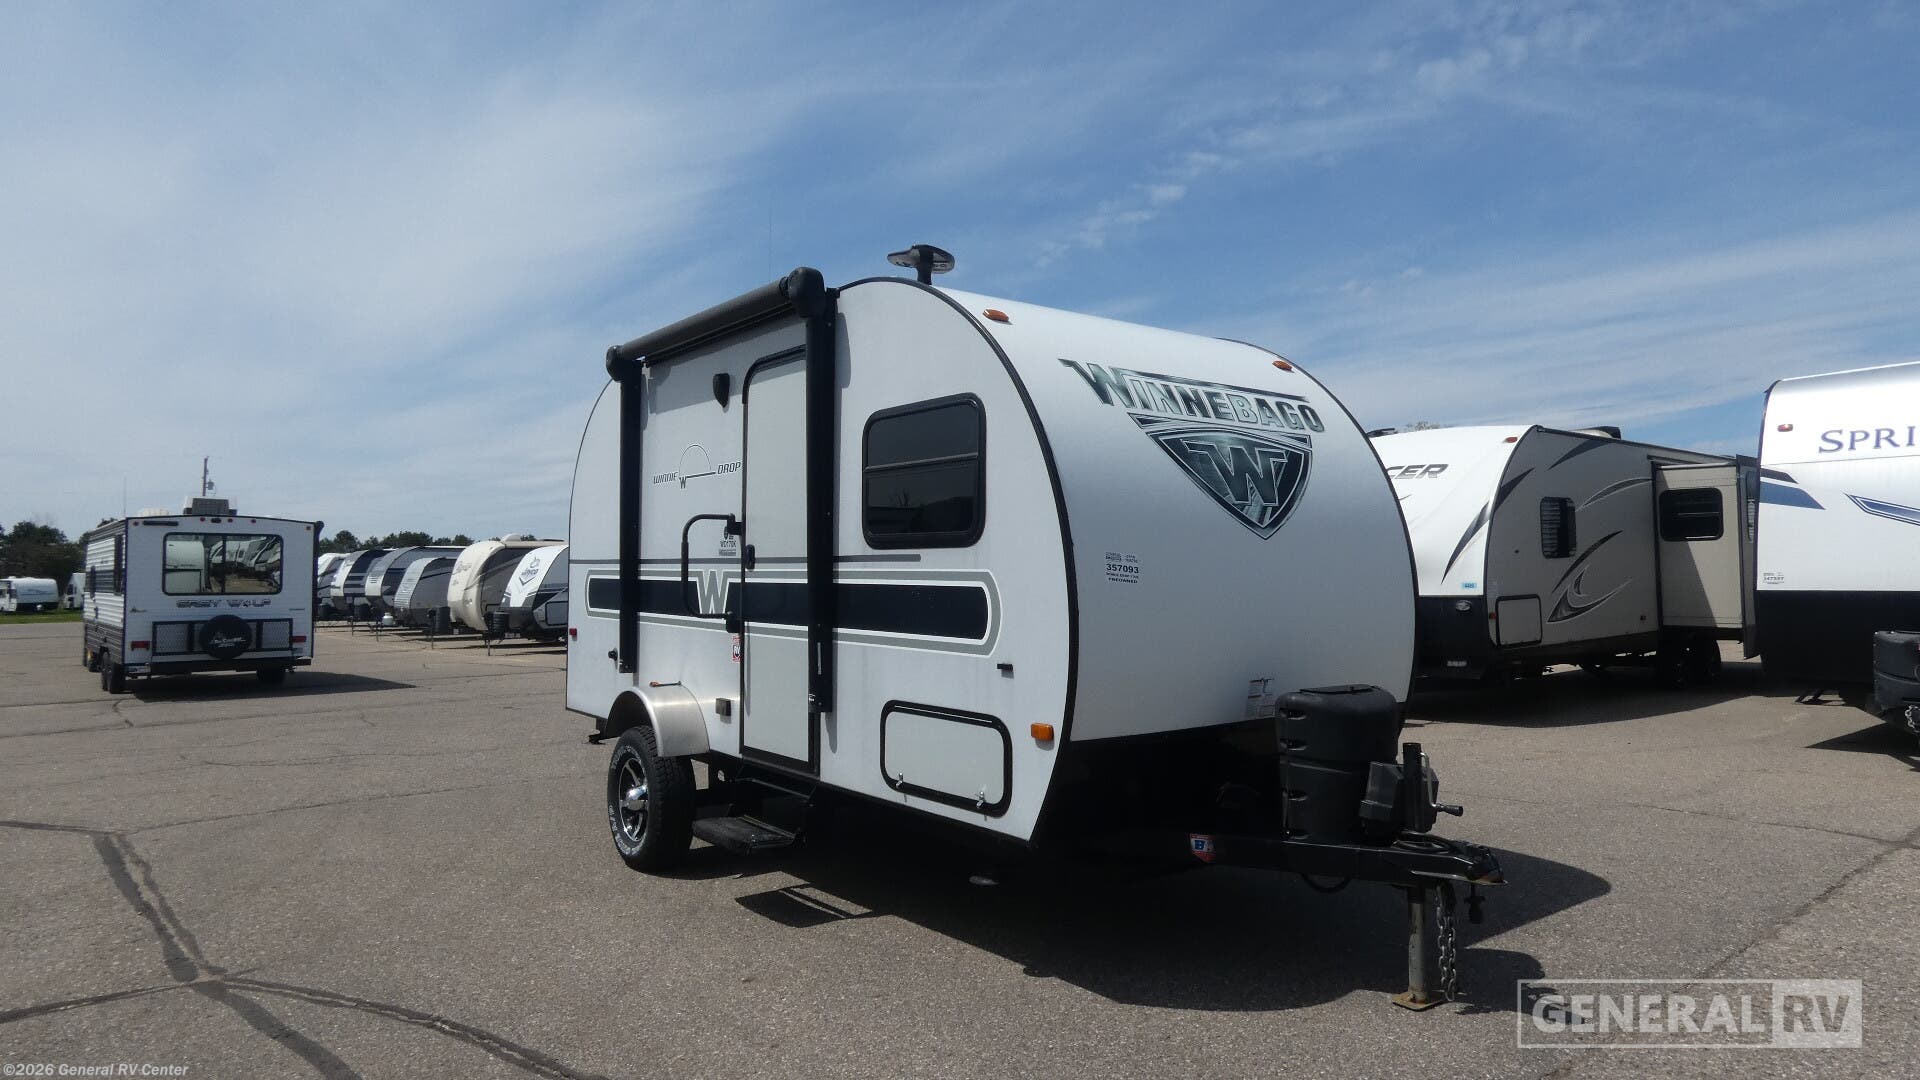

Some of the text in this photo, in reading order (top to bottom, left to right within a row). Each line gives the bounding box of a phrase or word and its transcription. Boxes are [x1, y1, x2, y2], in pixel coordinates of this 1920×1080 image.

[1058, 358, 1325, 433] WINNEBAGO
[717, 461, 742, 475] DROP
[1181, 439, 1288, 506] W
[1105, 563, 1139, 574] 357093
